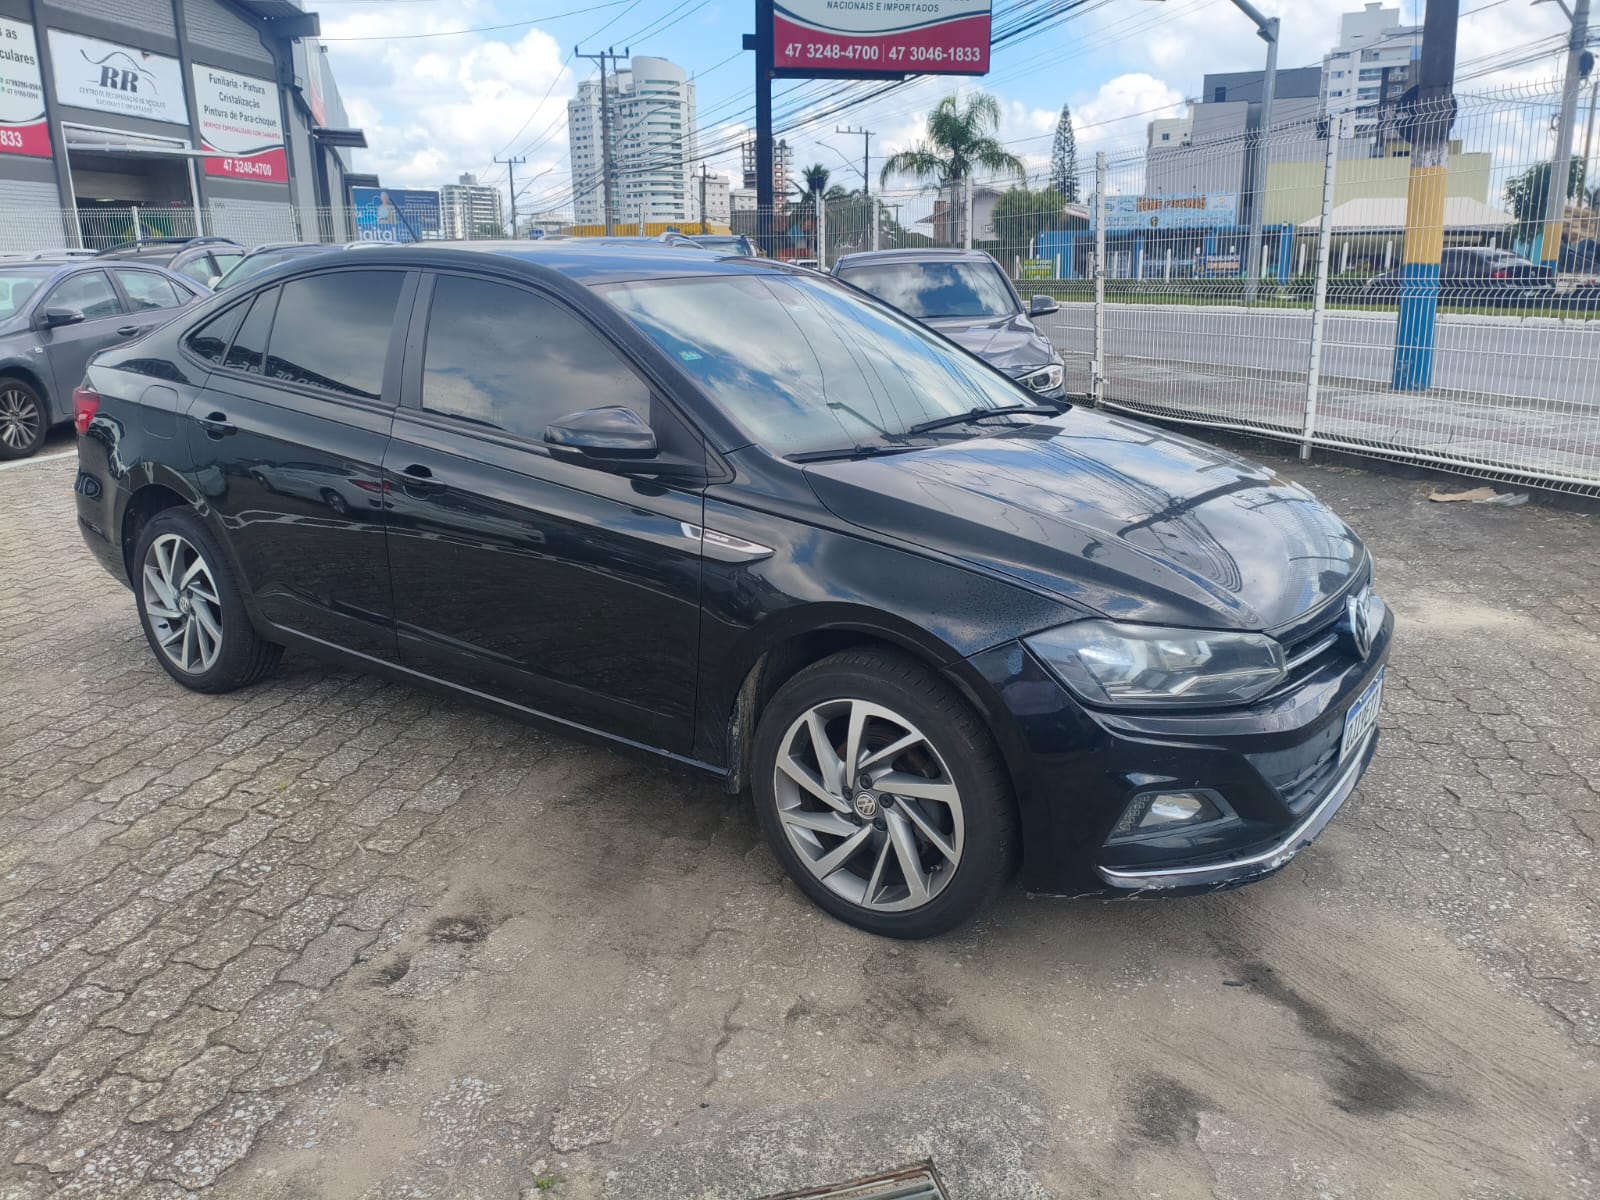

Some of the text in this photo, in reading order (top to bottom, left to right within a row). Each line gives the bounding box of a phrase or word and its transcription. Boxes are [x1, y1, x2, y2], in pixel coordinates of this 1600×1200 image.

[827, 1, 939, 12] NACIONAIS E IMPORTADOS
[5, 28, 18, 40] as
[0, 48, 36, 66] culares
[785, 43, 980, 61] 47 3248-4700 47 3046-1833
[99, 65, 138, 93] RR
[209, 73, 238, 89] Funilaria
[243, 81, 265, 95] Pintura
[219, 91, 260, 109] Cristalização
[204, 104, 228, 119] Pintura
[230, 111, 237, 120] de
[1, 130, 23, 147] 833
[223, 159, 272, 176] 47 3248-4700
[358, 226, 397, 241] igital
